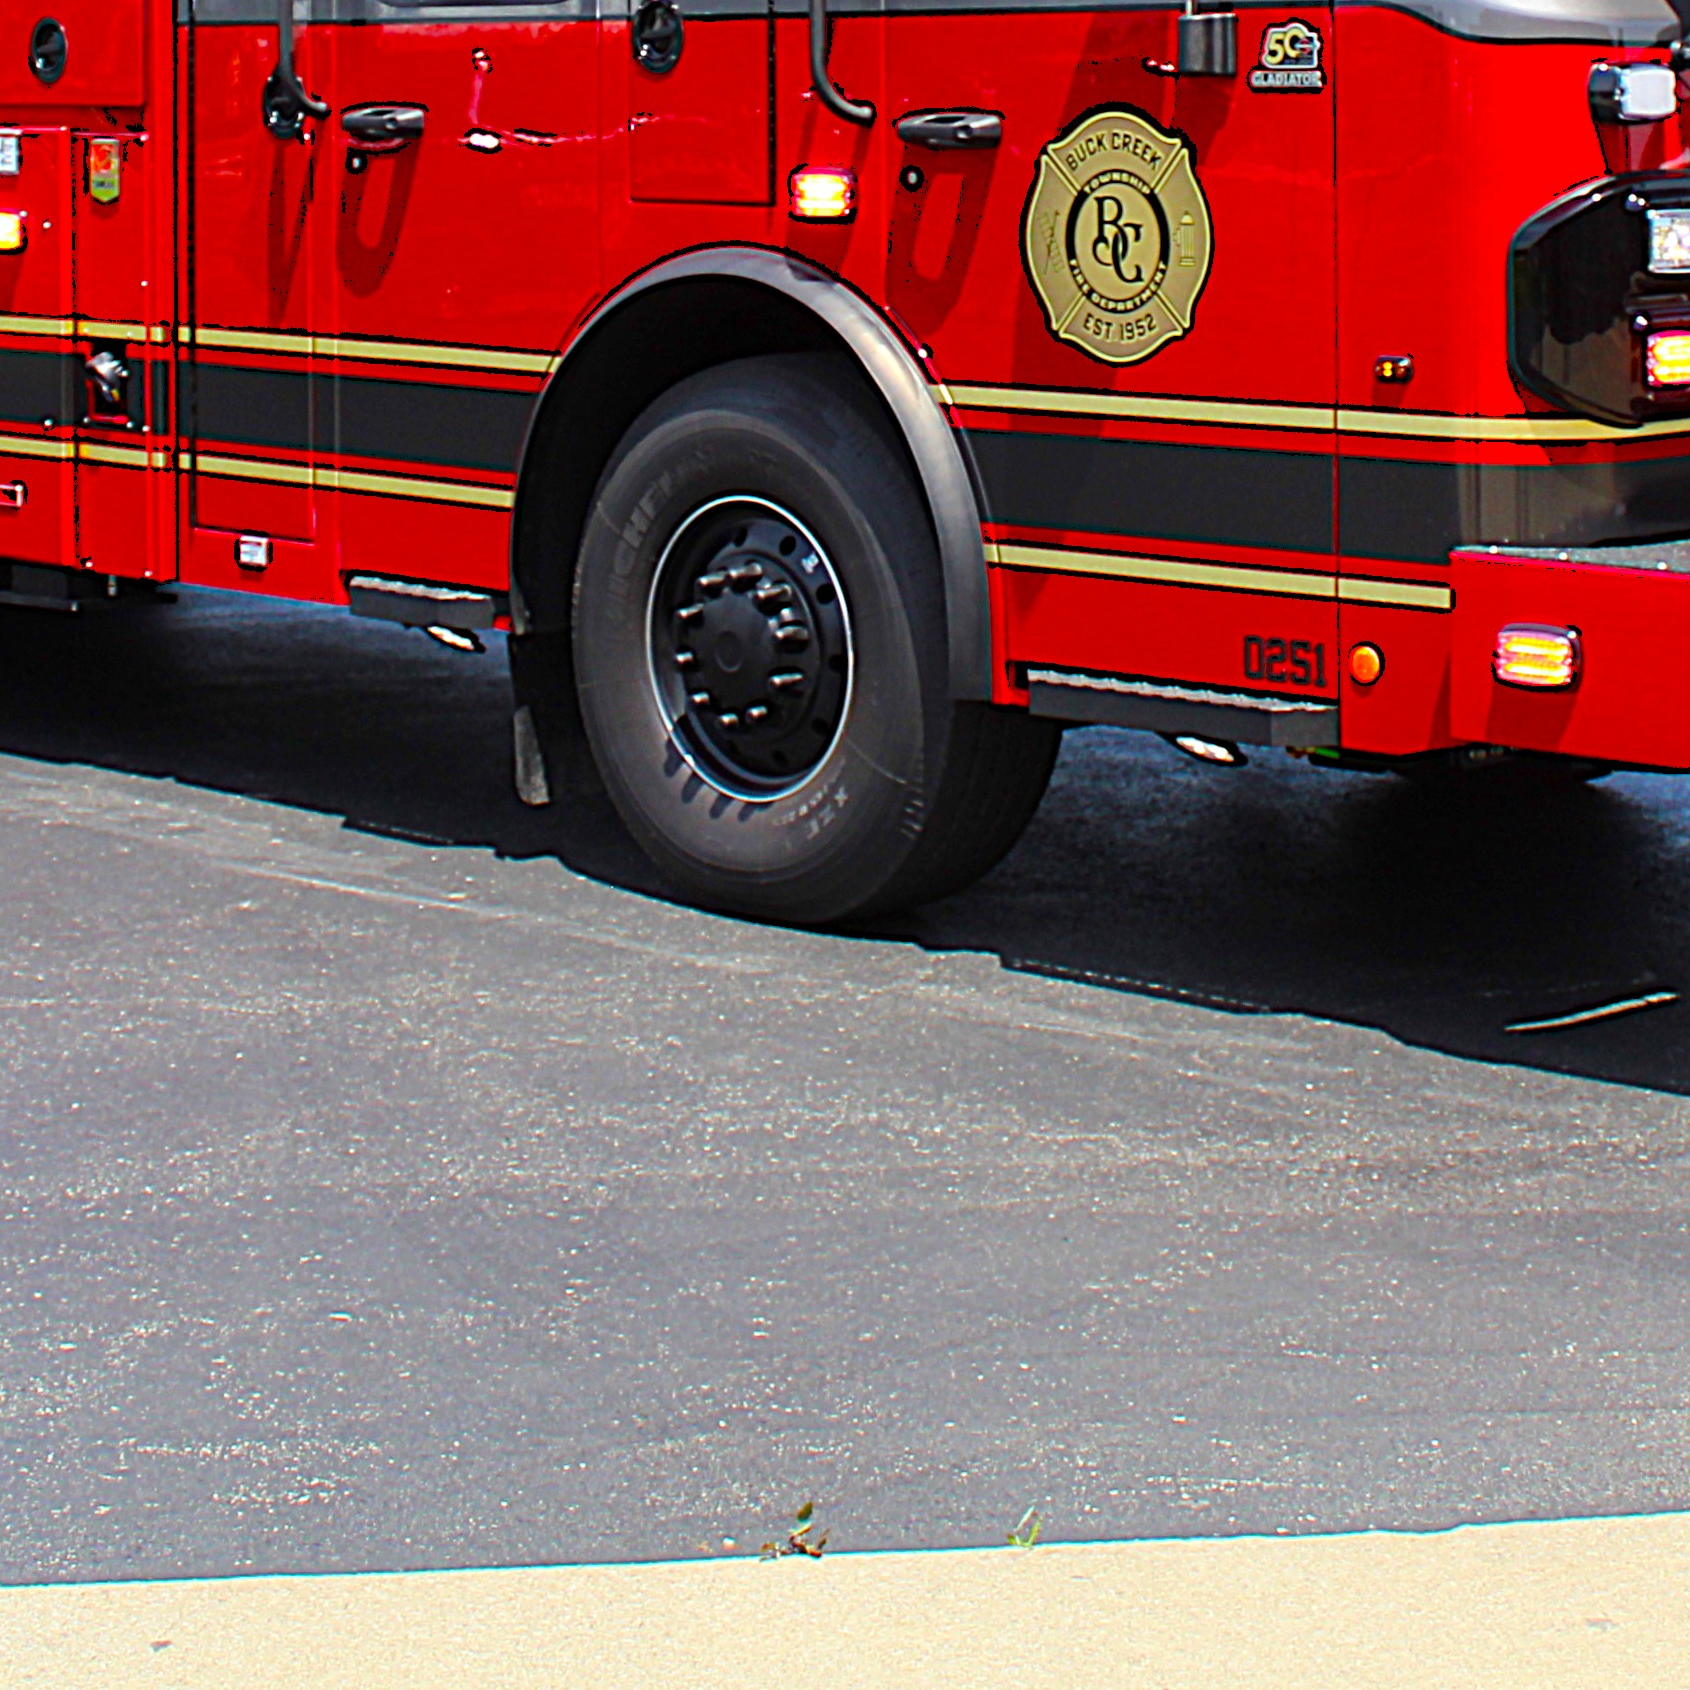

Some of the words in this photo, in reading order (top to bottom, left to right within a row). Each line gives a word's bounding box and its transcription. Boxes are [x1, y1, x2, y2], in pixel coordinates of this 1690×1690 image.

[1252, 71, 1322, 87] GLADIATOR
[1065, 132, 1106, 172] BUCK
[1111, 132, 1161, 172] CREEK
[1083, 171, 1151, 195] TOWNSHIP
[1069, 259, 1091, 294] FIRE
[1090, 261, 1167, 312] DEPARTMENT
[1082, 312, 1113, 340] EST
[1119, 312, 1157, 342] 1952
[1244, 635, 1327, 688] 0251
